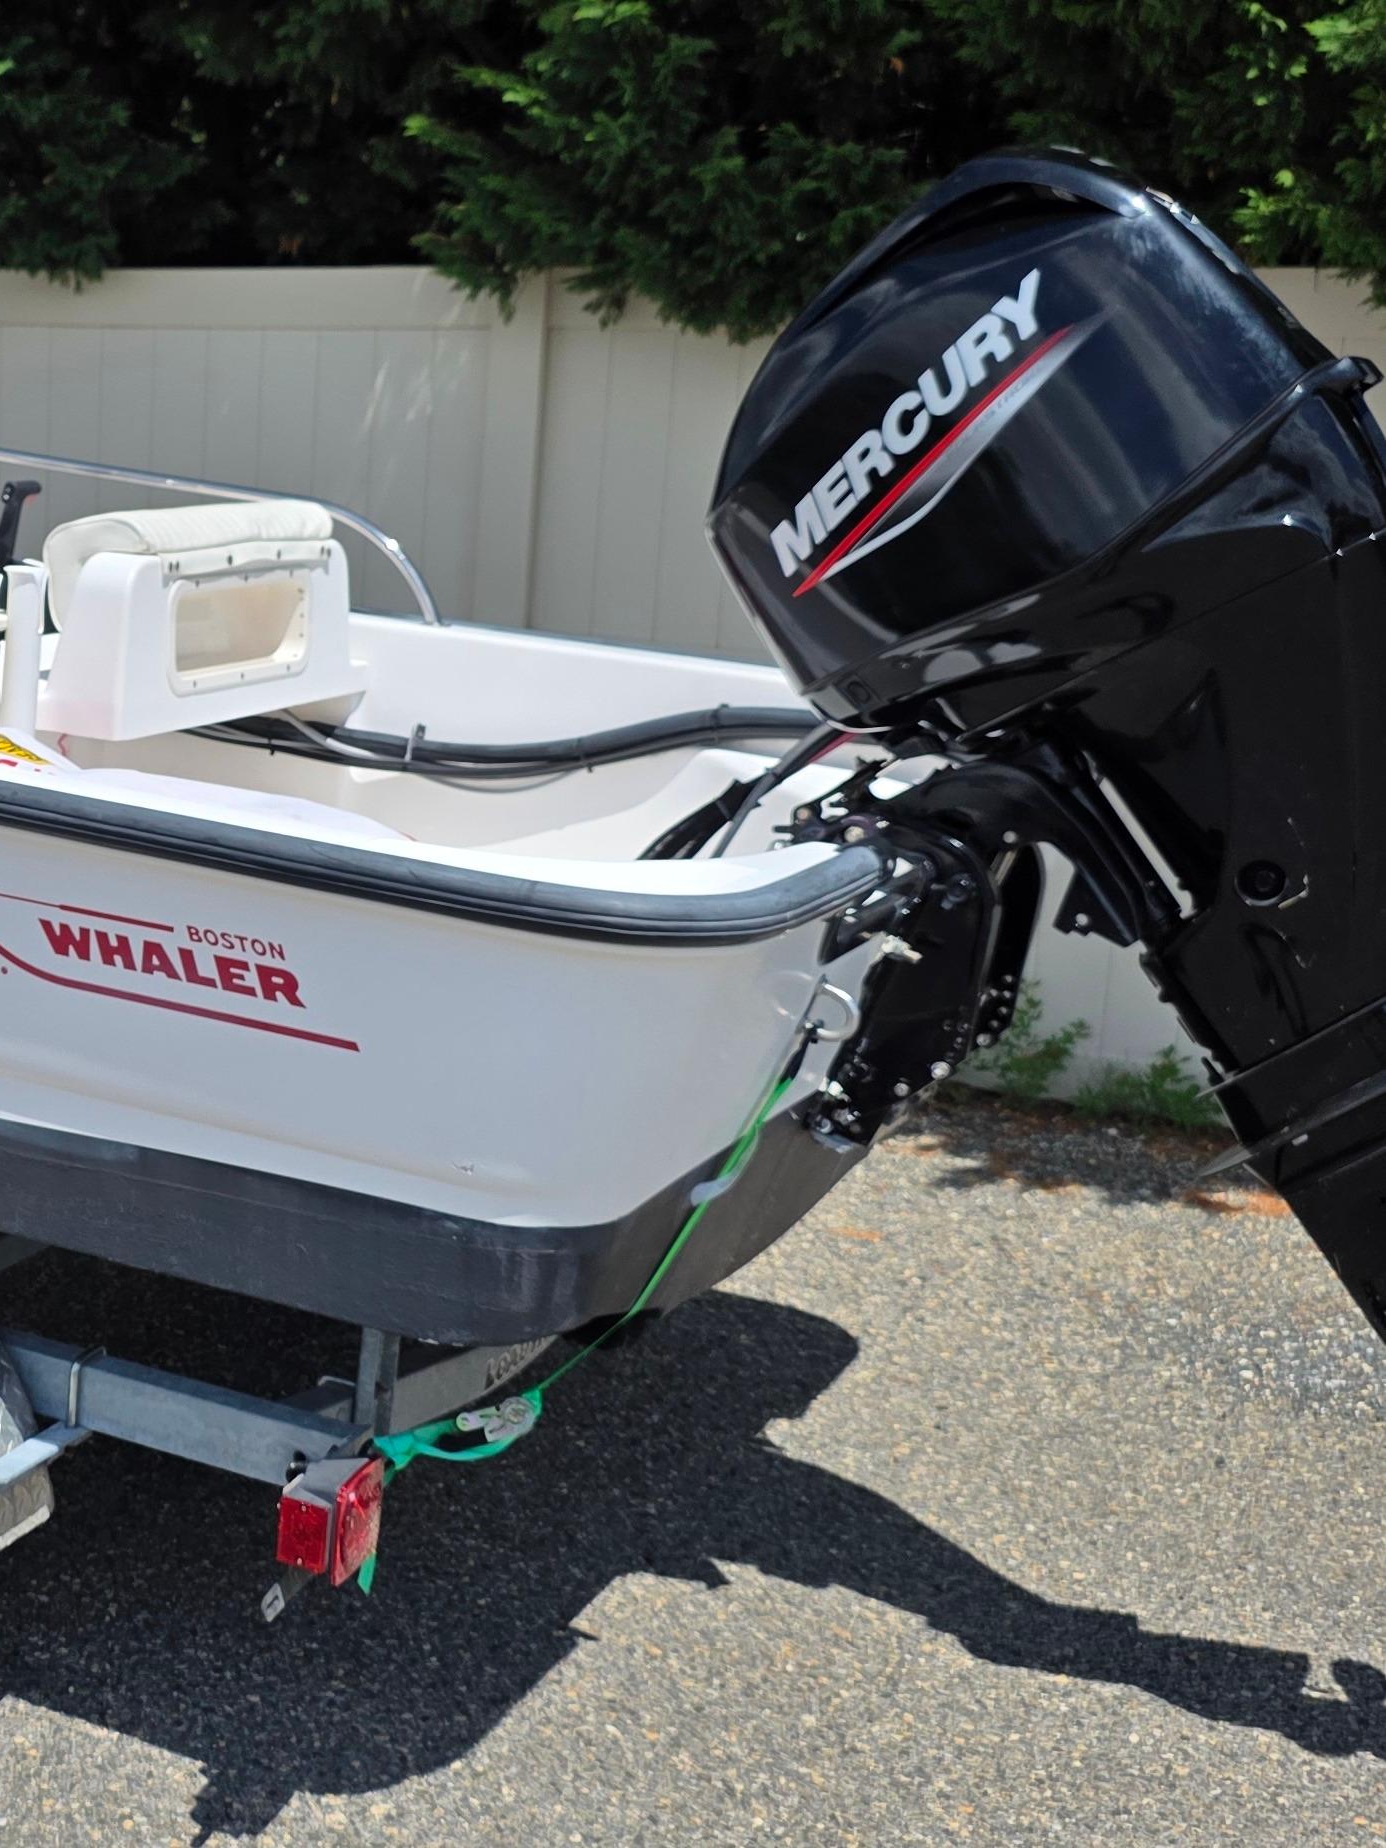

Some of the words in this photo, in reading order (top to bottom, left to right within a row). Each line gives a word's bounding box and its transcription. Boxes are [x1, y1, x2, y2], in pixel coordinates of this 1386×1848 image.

[770, 268, 1041, 578] MERCURY
[38, 918, 306, 1008] WHALER
[186, 925, 286, 961] BOSTON
